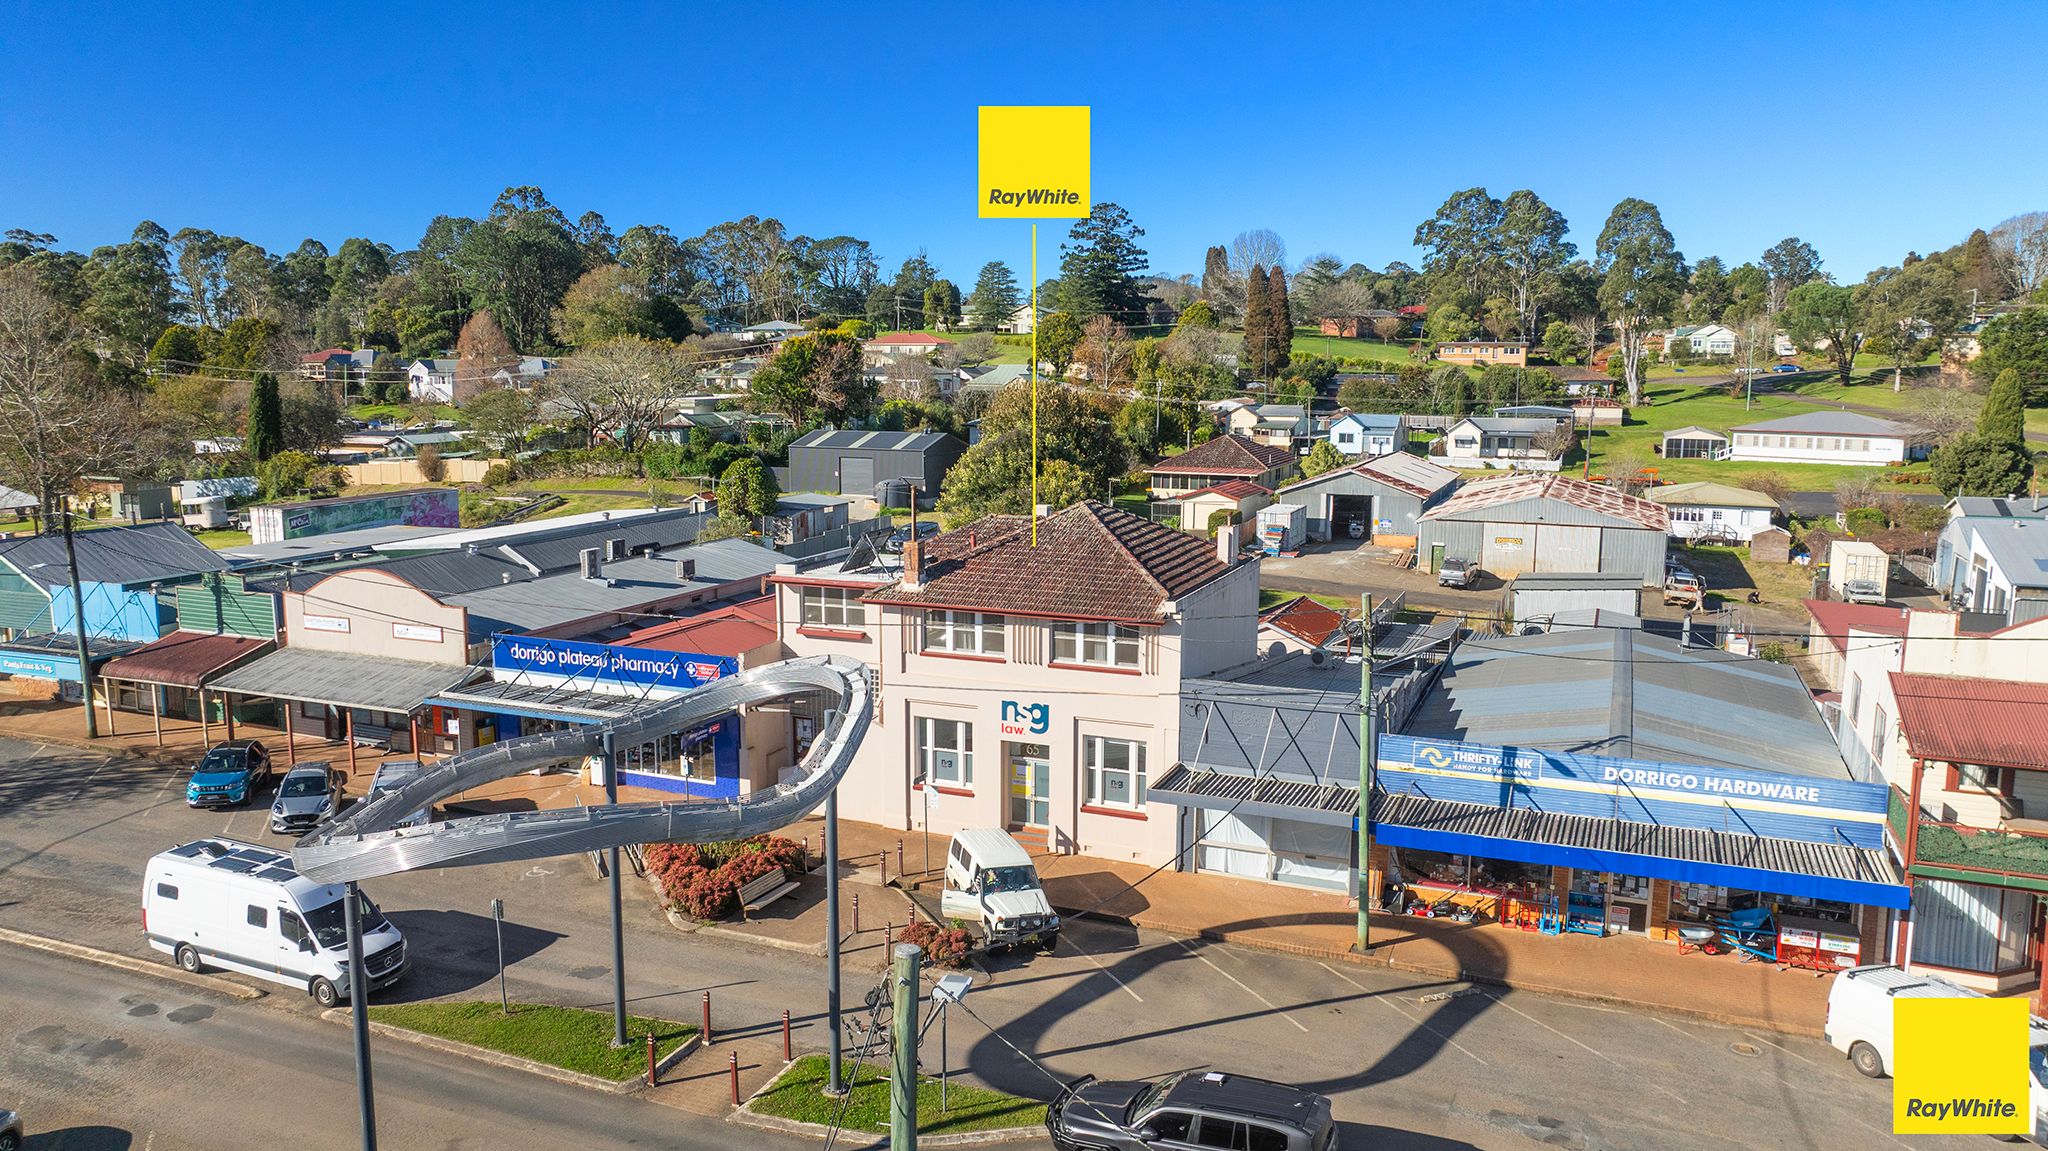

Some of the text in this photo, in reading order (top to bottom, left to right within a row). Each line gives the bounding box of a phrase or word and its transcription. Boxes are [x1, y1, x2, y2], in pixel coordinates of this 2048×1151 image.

[511, 643, 556, 665] dorrigo
[559, 648, 608, 668] plateau
[611, 655, 680, 679] pharmacy
[1001, 700, 1050, 734] nsg
[1026, 745, 1040, 756] 65
[1453, 751, 1533, 769] THRIFTY-LINK
[1453, 764, 1476, 772] HANDY
[1494, 767, 1532, 777] HARDWARE
[1604, 766, 1820, 802] DORRIGO HARDWARE
